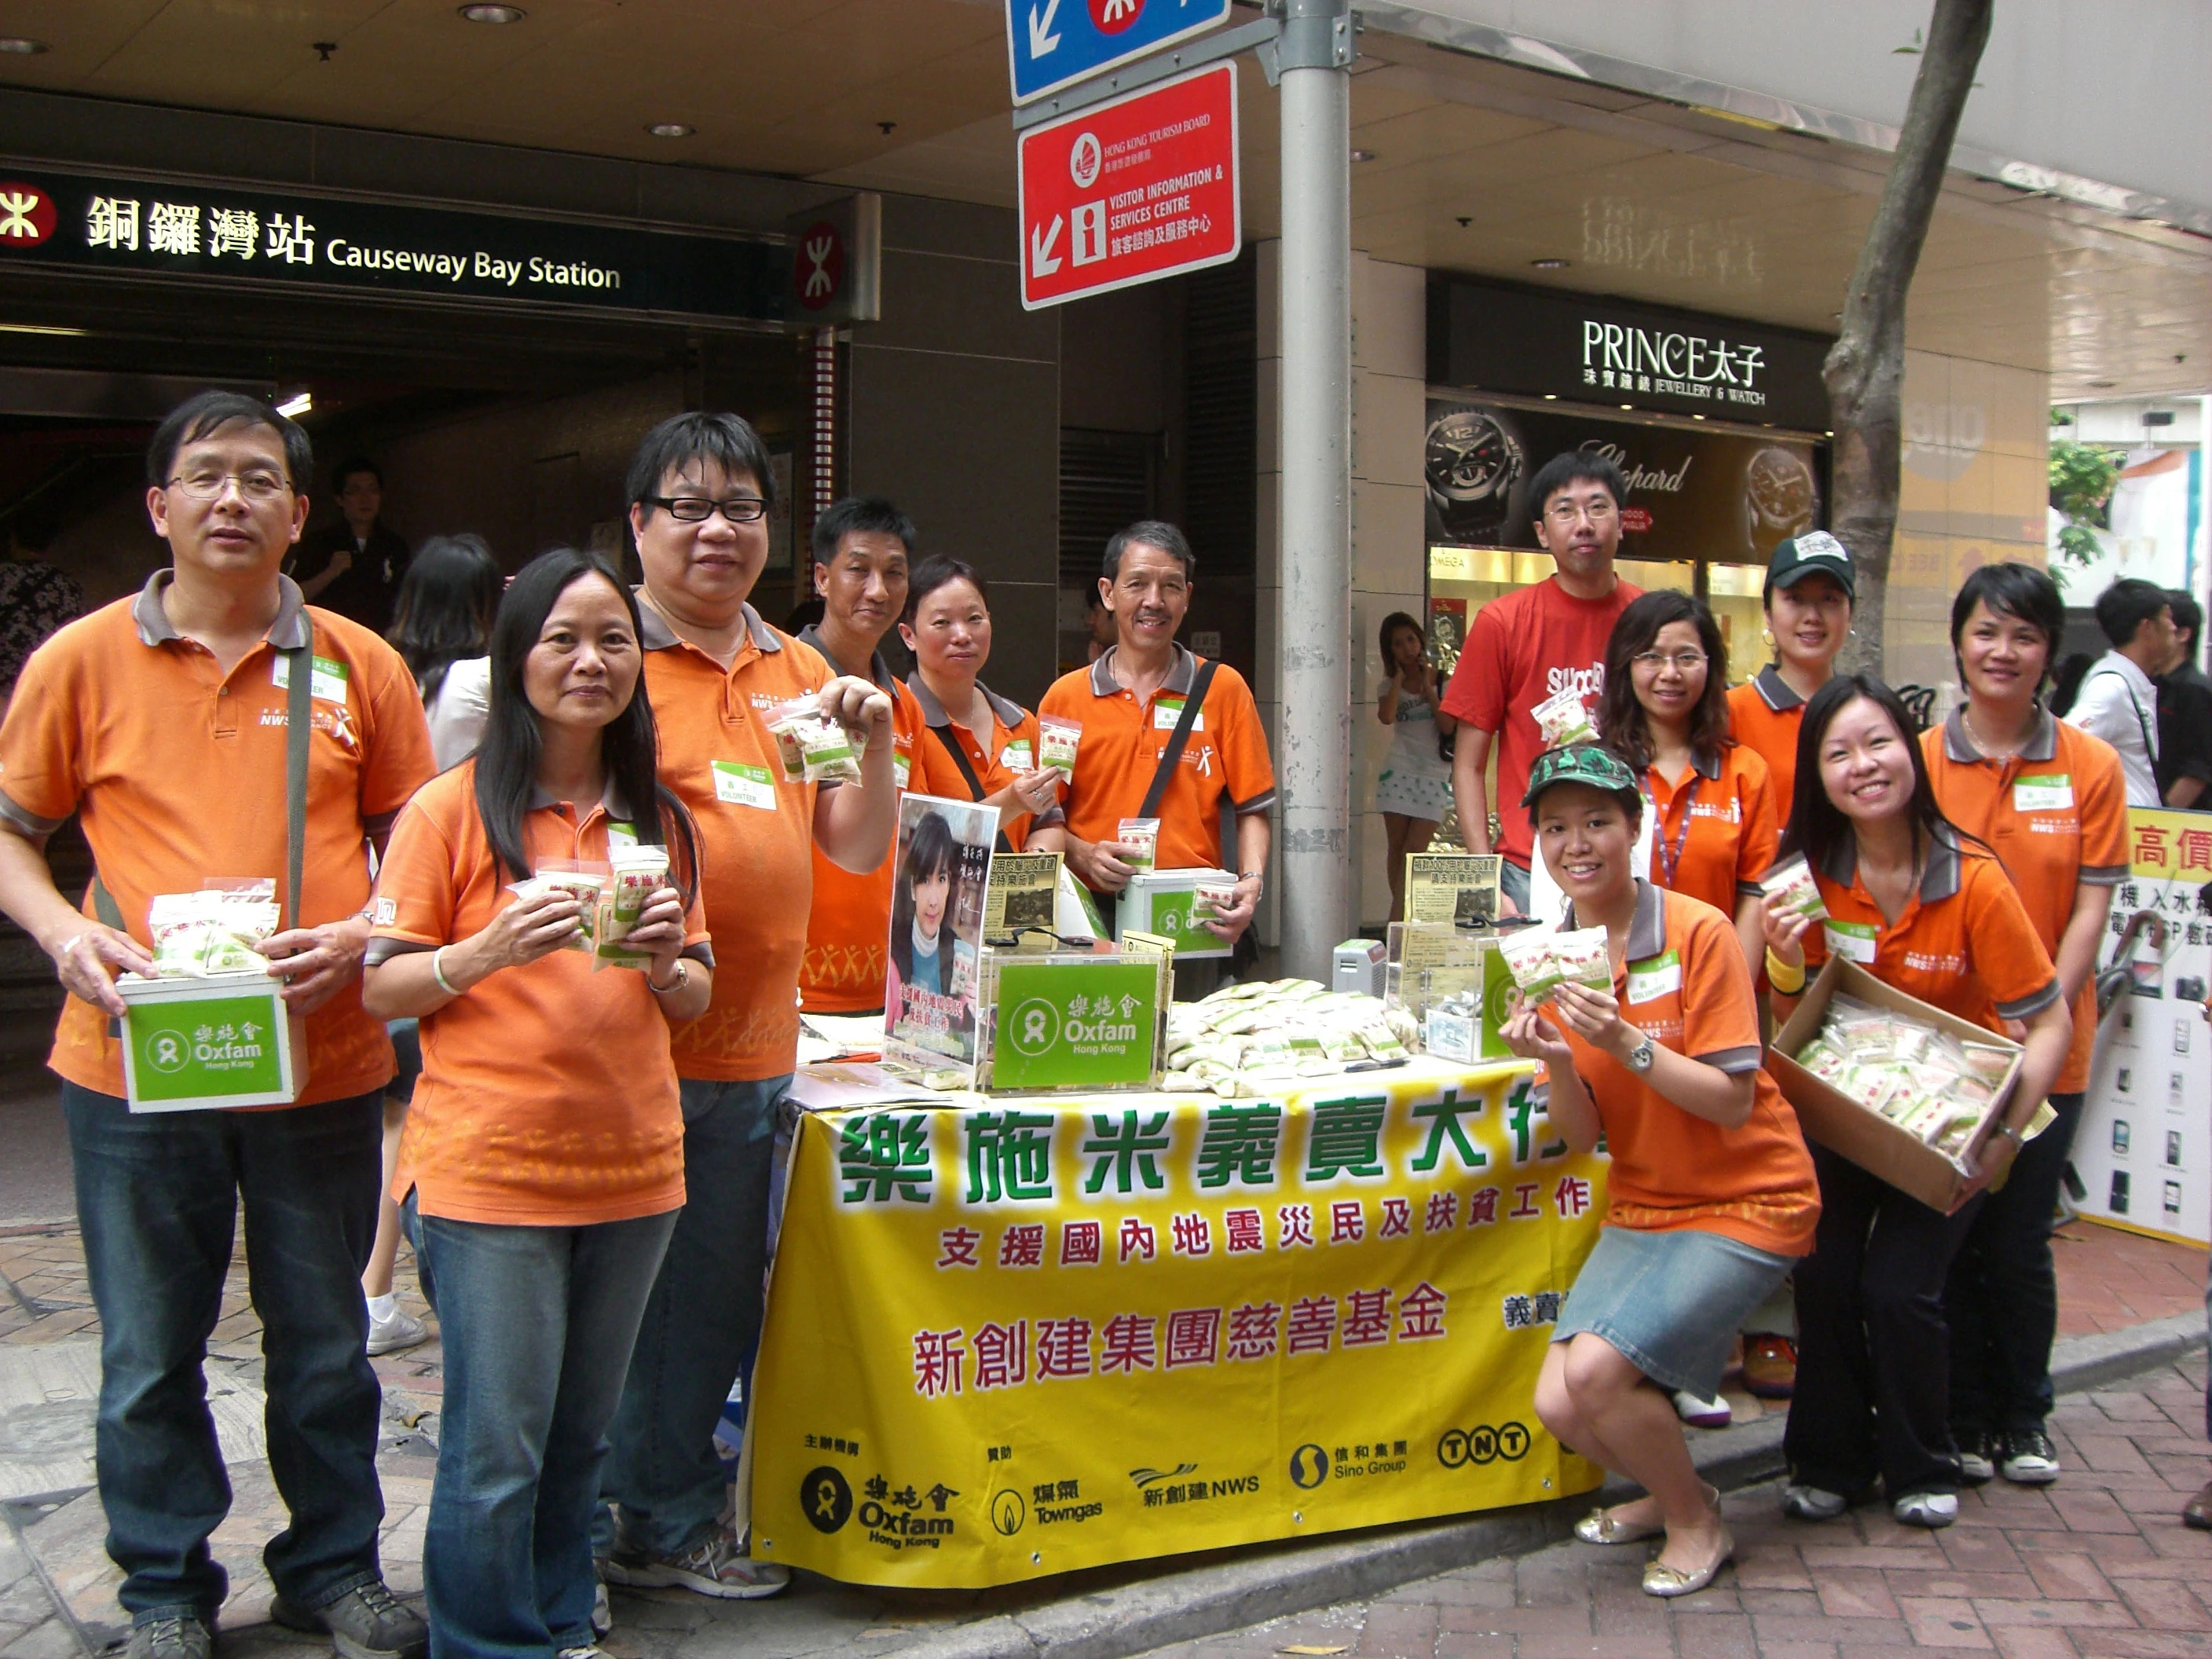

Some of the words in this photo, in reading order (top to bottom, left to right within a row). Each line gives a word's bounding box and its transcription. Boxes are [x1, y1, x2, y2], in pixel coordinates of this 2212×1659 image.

[1104, 141, 1125, 157] HONG
[1126, 134, 1147, 150] KONG
[1148, 123, 1181, 142] TOURISM
[1183, 114, 1210, 132] BOARD
[1110, 188, 1144, 210] VISITOR
[1148, 167, 1211, 199] INFORMATION
[1216, 164, 1223, 179] &
[1111, 206, 1151, 230] SERVICES
[1155, 195, 1190, 218] CENTRE
[86, 195, 316, 265] 銅鑼灣站
[326, 239, 466, 281] Causeway
[474, 251, 522, 286] Bay
[529, 257, 621, 289] Station
[1583, 320, 1711, 381] PRINCE
[1708, 339, 1766, 387] 太子
[1654, 379, 1712, 399] JEWELLERY
[1716, 387, 1723, 399] &
[1728, 389, 1766, 405] WATCH
[2134, 825, 2212, 872] 高價
[1064, 1020, 1137, 1042] Oxfam
[195, 1042, 262, 1061] Oxfam
[206, 1062, 229, 1071] Hong
[230, 1060, 255, 1069] Kong
[1073, 1045, 1098, 1056] Hong
[1101, 1043, 1126, 1055] Kong
[938, 1177, 1589, 1267] 支援國內地震災民及扶貧工作
[914, 1282, 1447, 1396] 新創建集團慈善基金
[1504, 1292, 1569, 1327] 義賣
[1441, 1425, 1526, 1466] TNT
[1335, 1464, 1364, 1478] Sino
[1368, 1460, 1406, 1474] Group
[1212, 1476, 1260, 1498] NWS
[859, 1500, 954, 1536] Oxfam
[1034, 1502, 1102, 1525] Towngas
[869, 1531, 902, 1550] Hong
[905, 1537, 940, 1549] Kong
